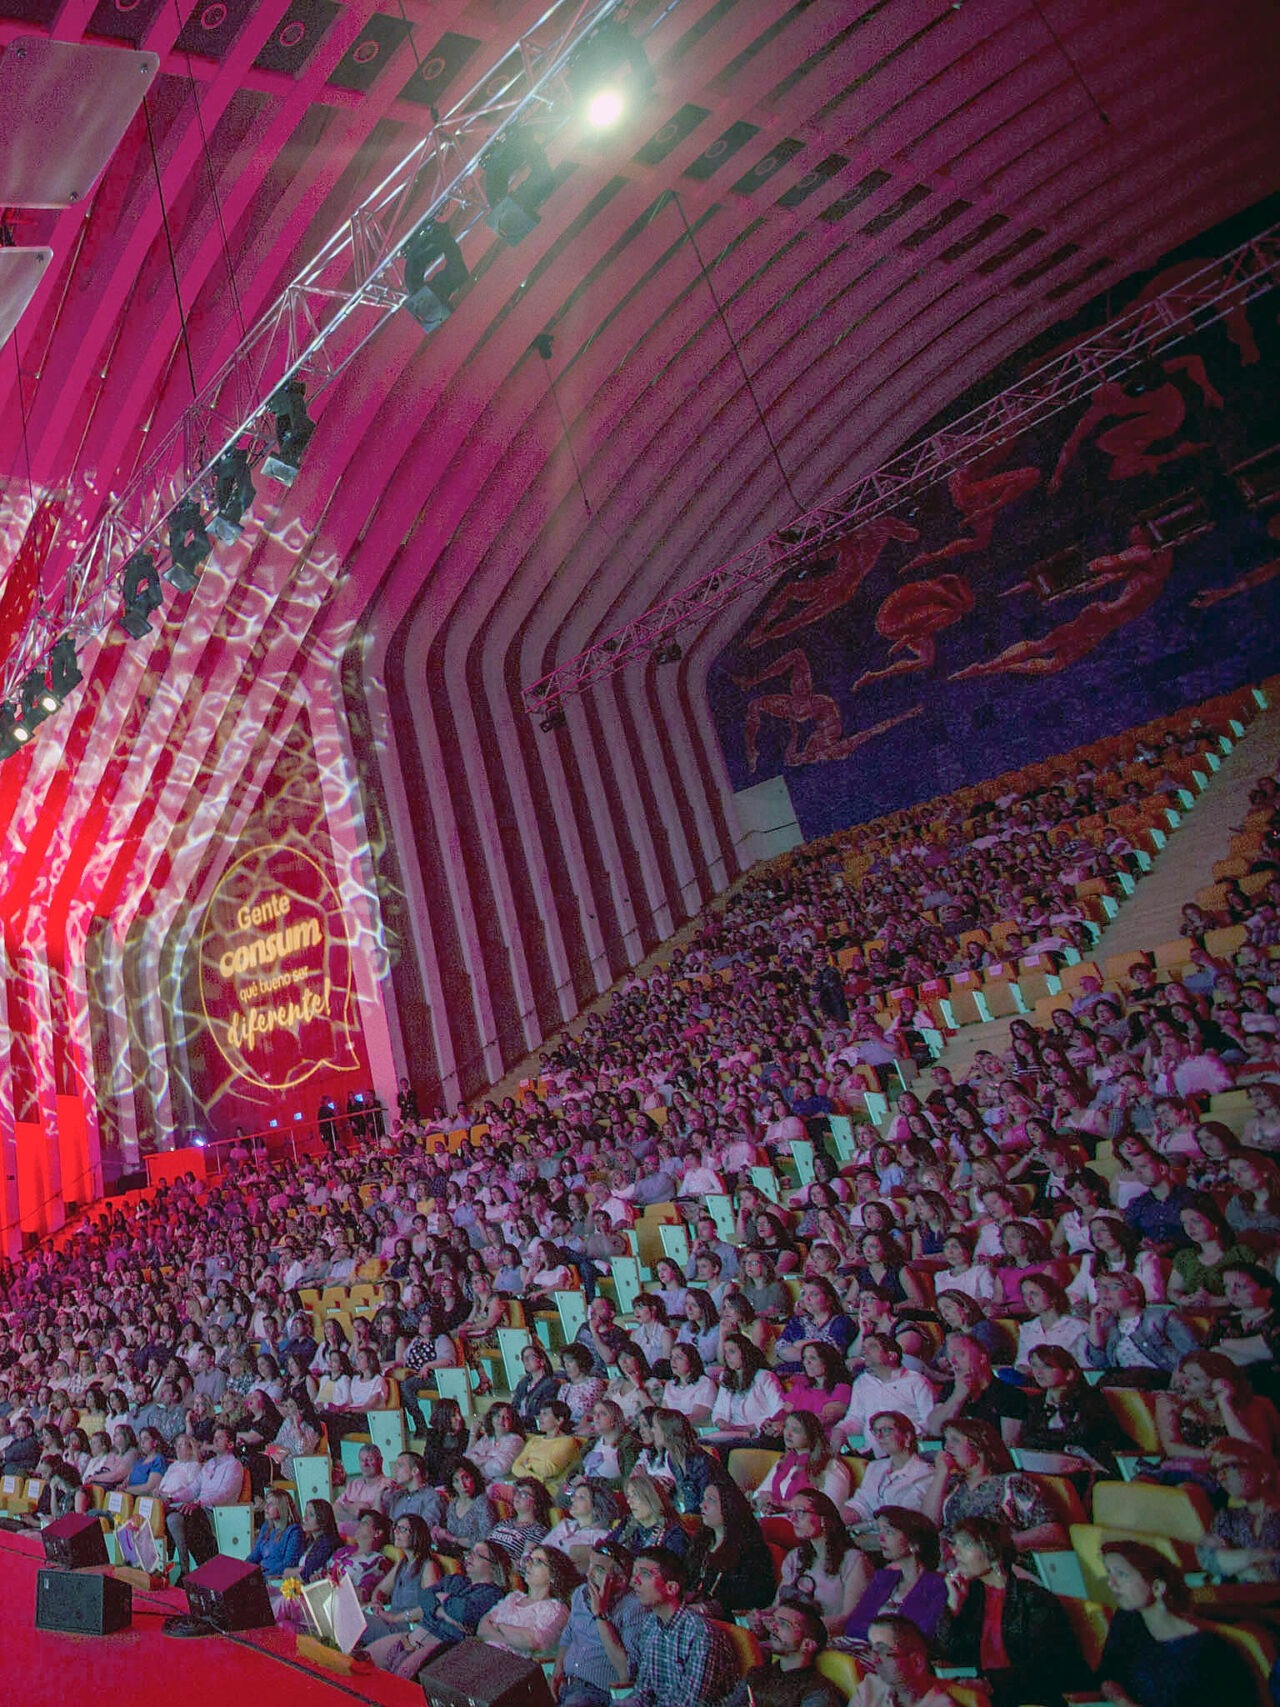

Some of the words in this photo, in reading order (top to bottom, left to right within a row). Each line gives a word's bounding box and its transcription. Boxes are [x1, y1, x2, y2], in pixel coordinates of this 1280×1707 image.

[237, 894, 290, 929] Gente
[219, 917, 323, 978] consum
[239, 981, 259, 1003] qué
[259, 972, 291, 994] bueno
[292, 965, 310, 983] ser
[227, 976, 332, 1051] diferente!
